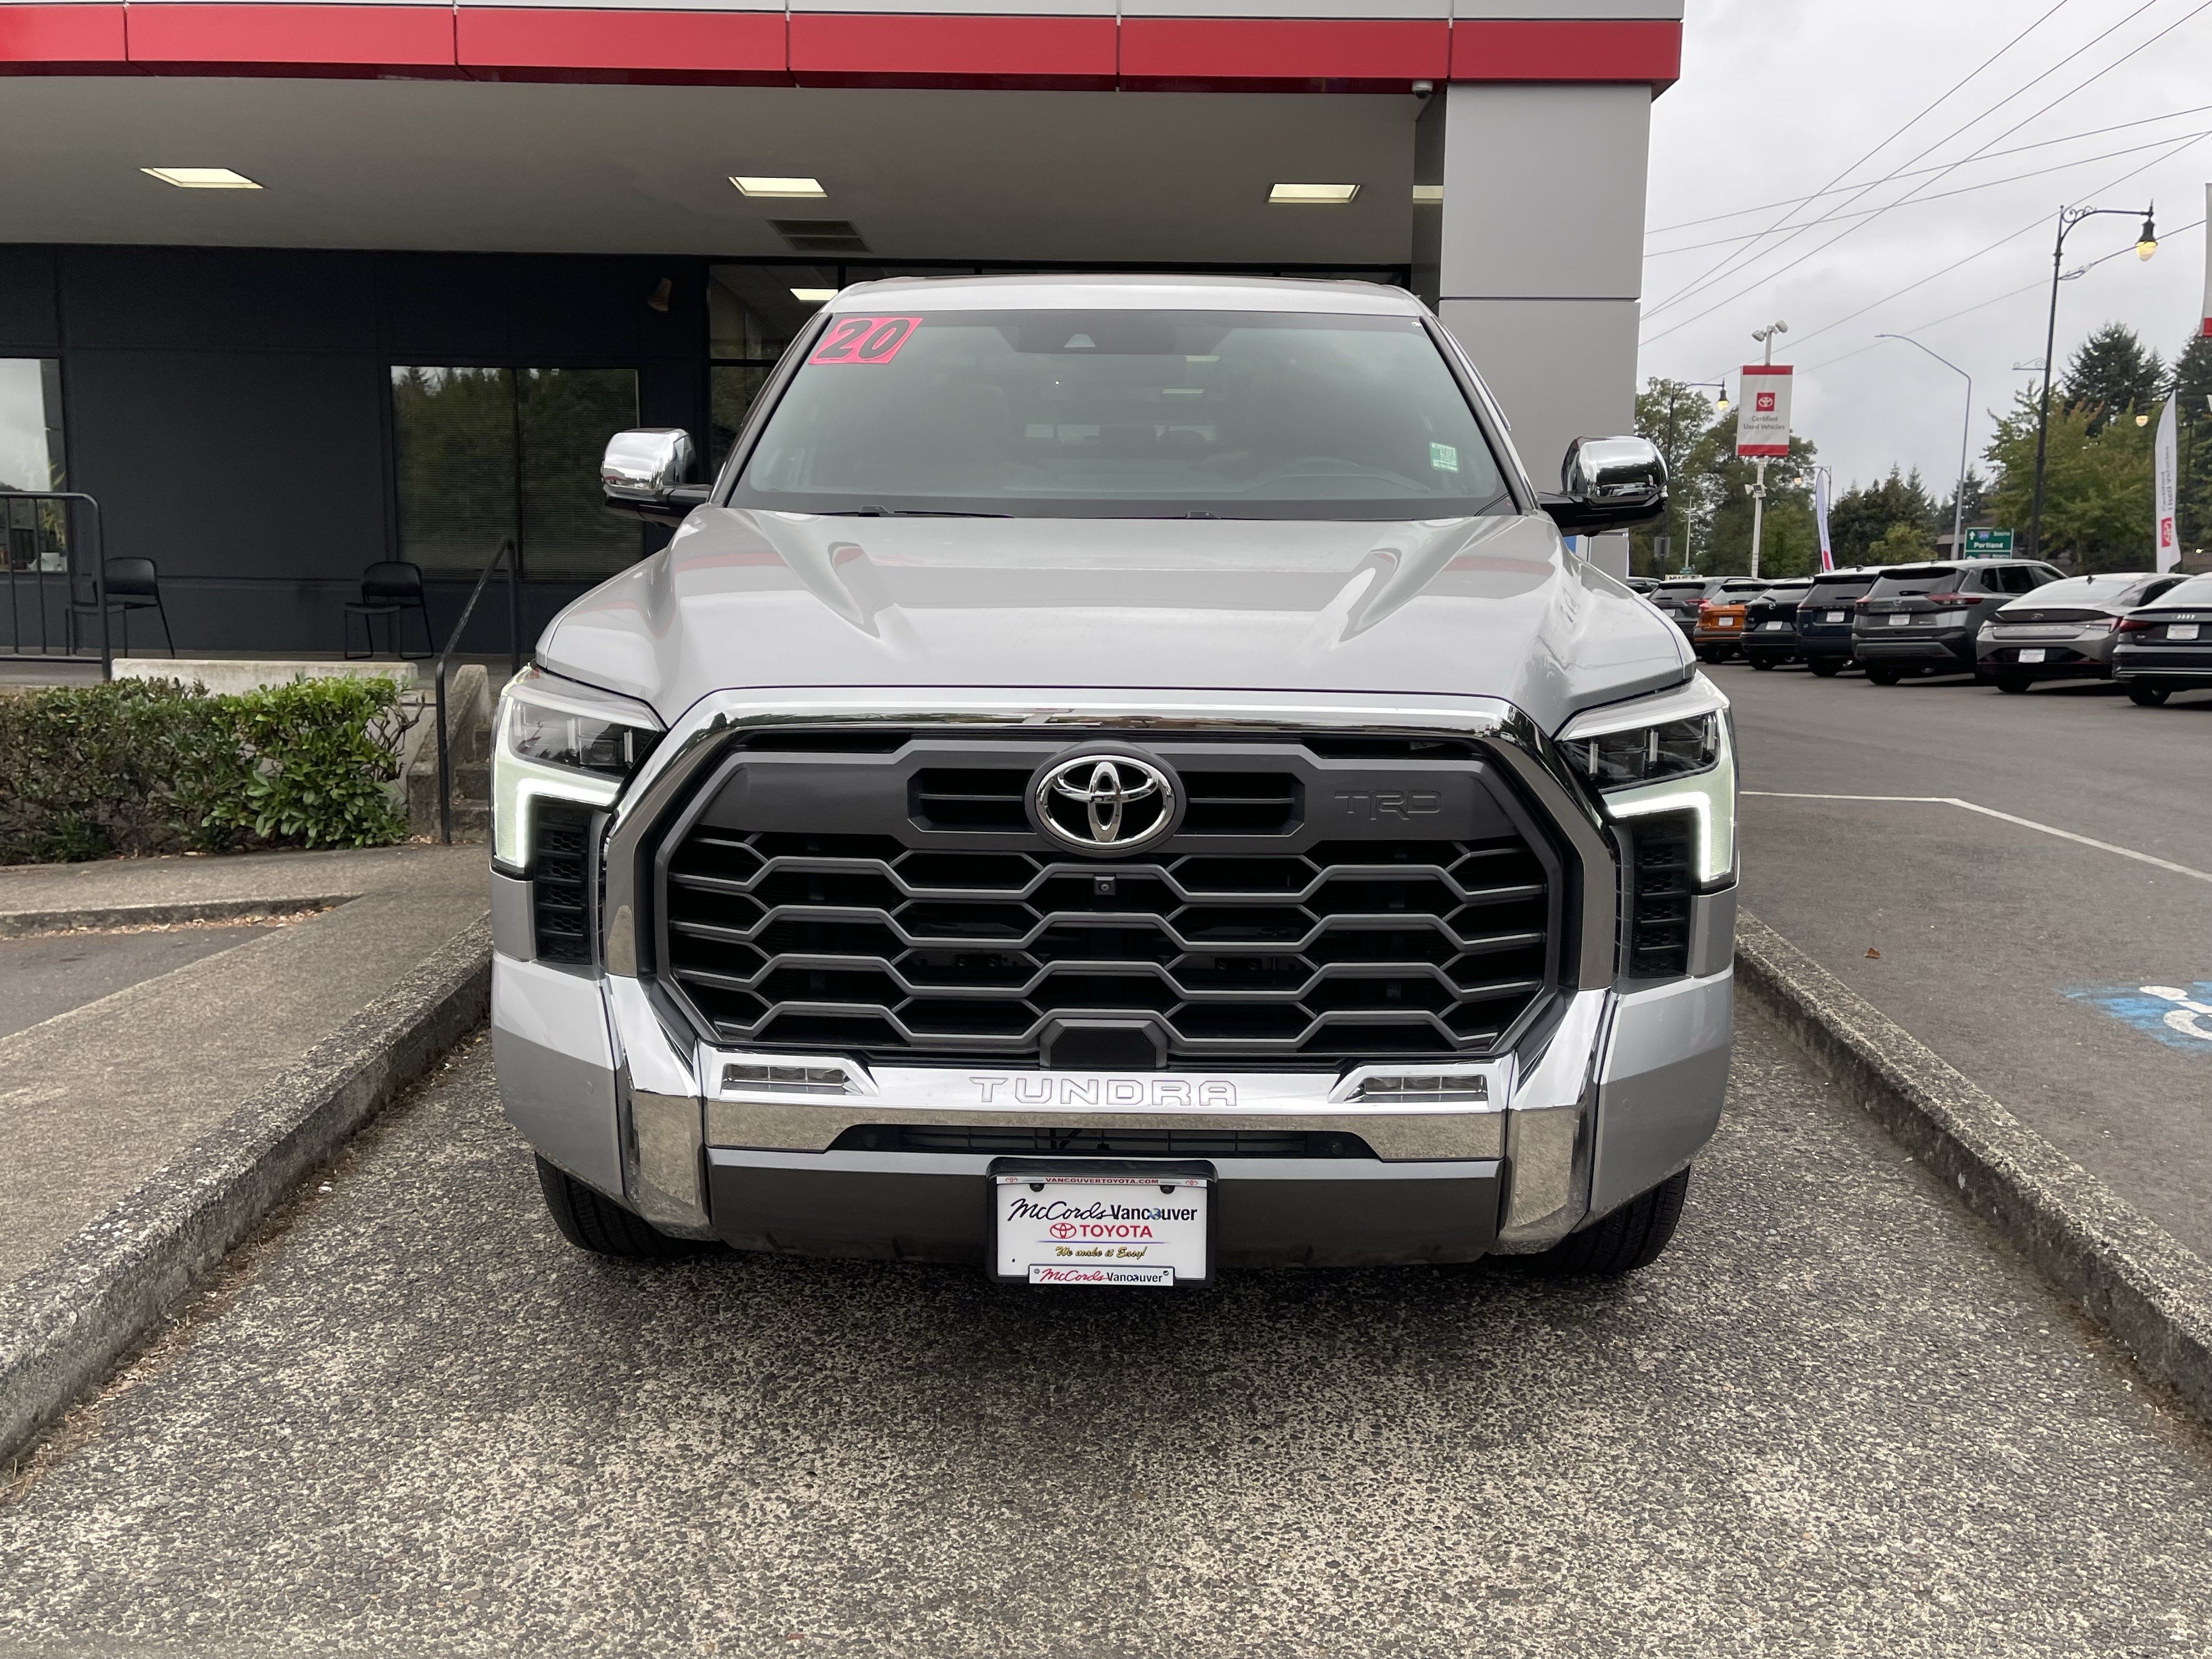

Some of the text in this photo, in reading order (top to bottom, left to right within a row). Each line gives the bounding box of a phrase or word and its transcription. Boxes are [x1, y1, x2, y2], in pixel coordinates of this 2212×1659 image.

[816, 318, 911, 360] 20
[1334, 789, 1441, 821] TRD
[968, 1076, 1238, 1107] TUNDRA
[1007, 1198, 1198, 1221] McCords Vancouver
[1079, 1224, 1153, 1238] TOYOTA
[1055, 1245, 1148, 1260] We make it Easy!
[1040, 1268, 1163, 1283] McCords Vancouver
